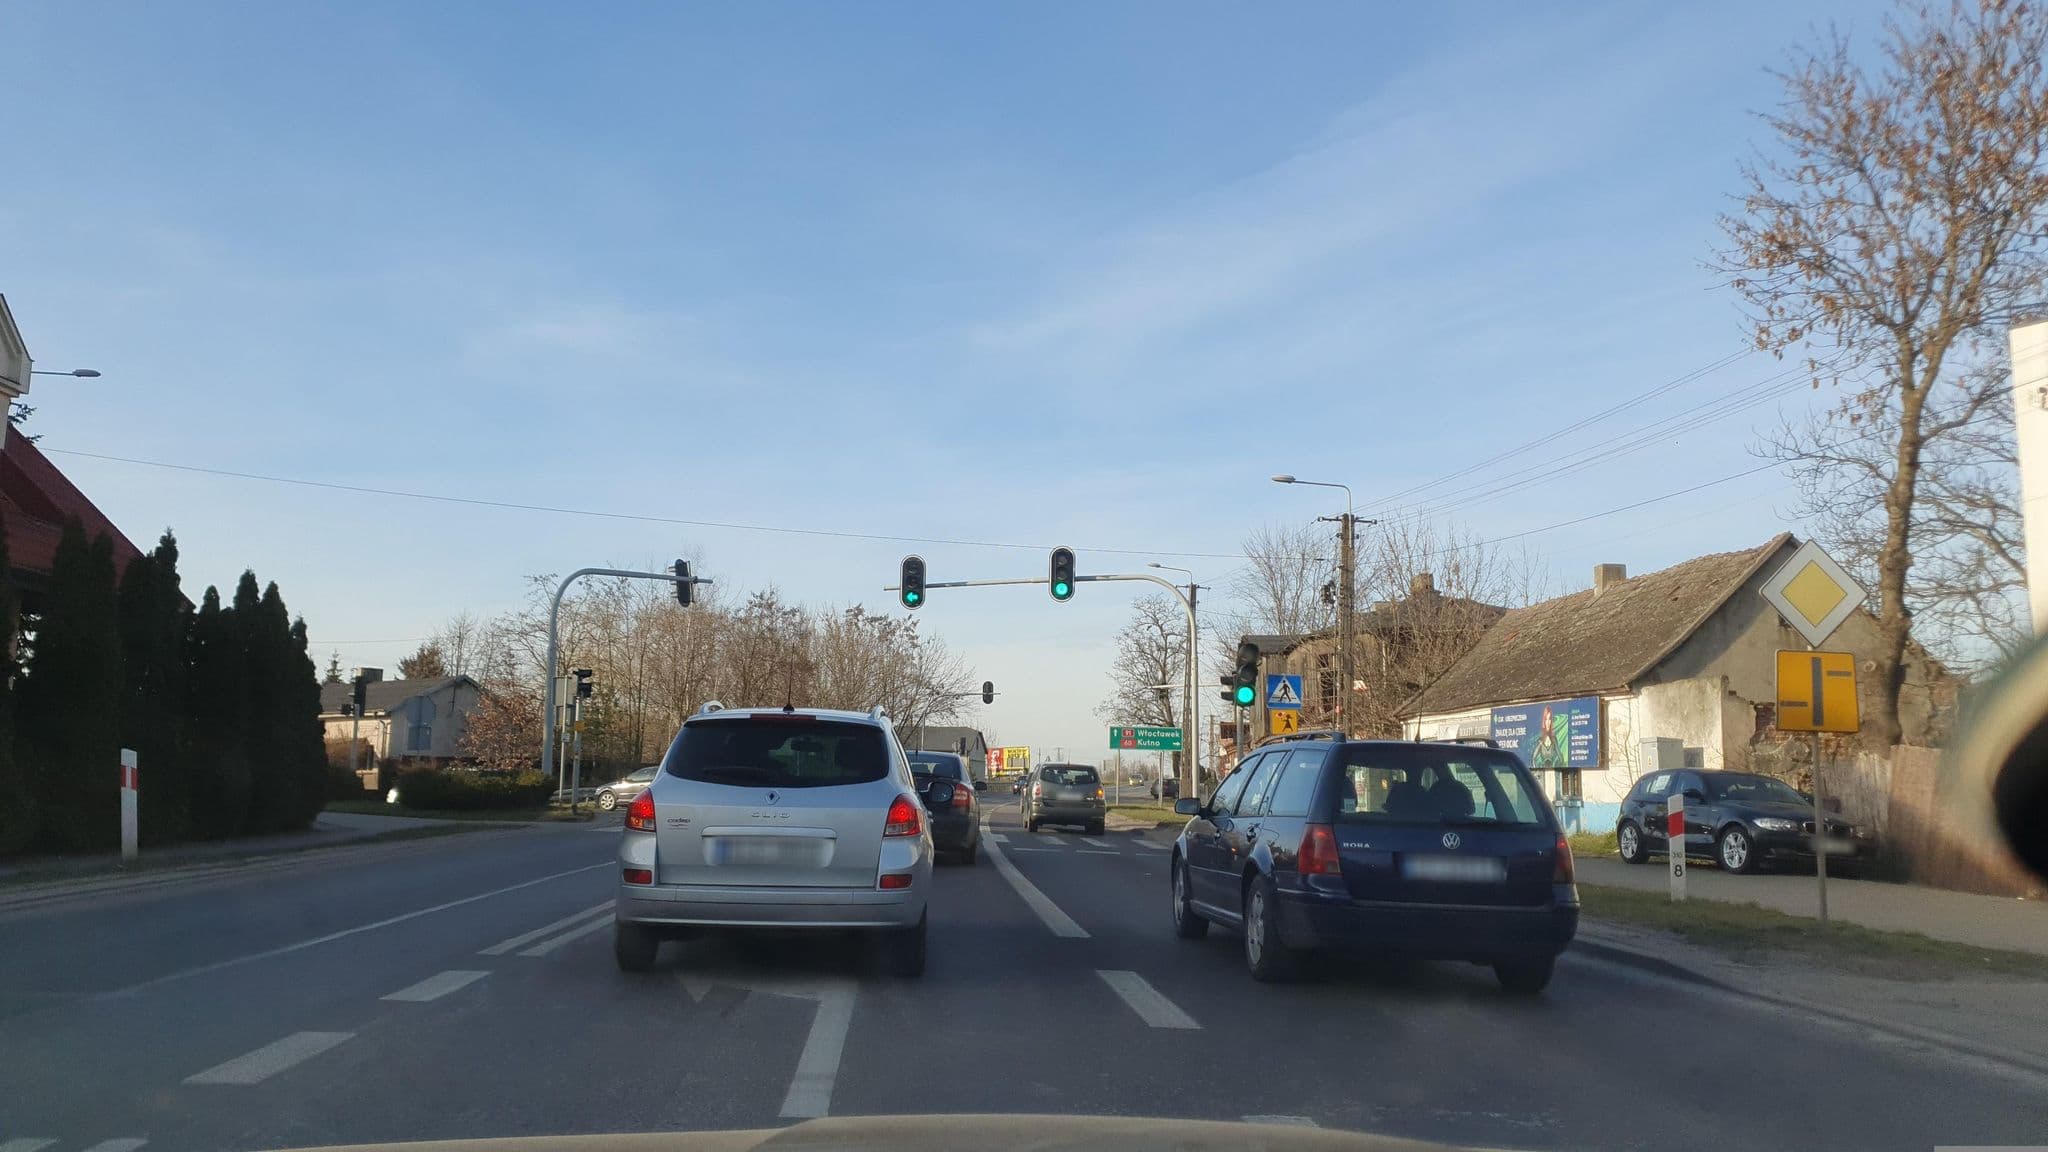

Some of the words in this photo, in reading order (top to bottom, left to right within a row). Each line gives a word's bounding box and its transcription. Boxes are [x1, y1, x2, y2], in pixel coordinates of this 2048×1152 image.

[1137, 729, 1180, 738] Włocławek
[1137, 739, 1161, 747] Kutno
[751, 811, 791, 819] CLIO
[1674, 864, 1683, 877] 8
